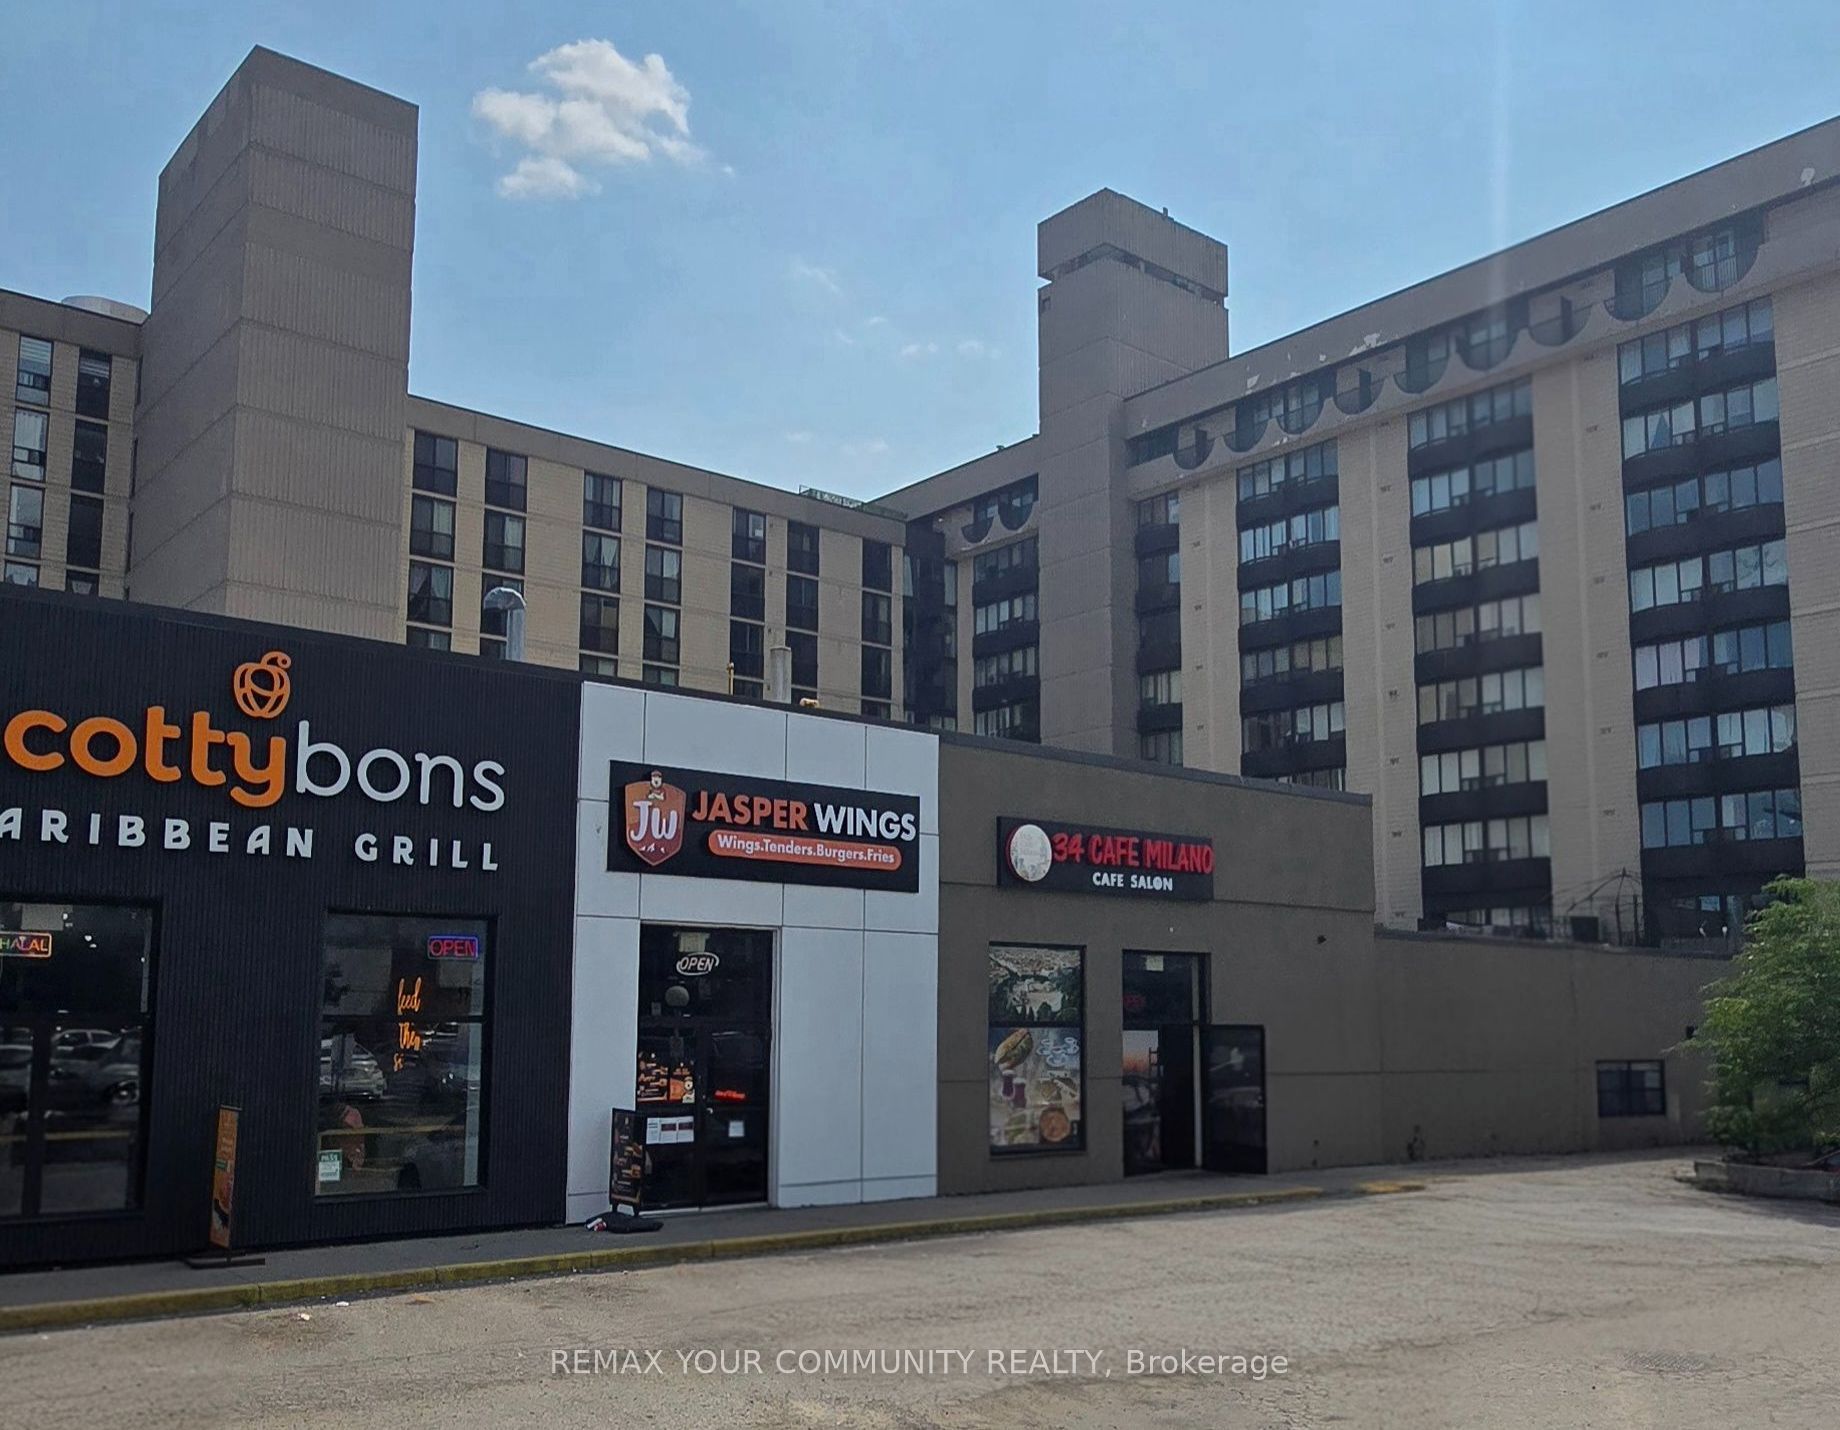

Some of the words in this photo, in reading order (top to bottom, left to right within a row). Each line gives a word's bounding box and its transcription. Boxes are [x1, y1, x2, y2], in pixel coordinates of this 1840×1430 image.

[4, 706, 506, 812] cottybons
[692, 790, 809, 831] JASPER
[813, 803, 917, 842] WINGS
[0, 807, 313, 858] ARIBBEAN
[355, 833, 499, 872] GRILL
[1051, 832, 1085, 864] 34
[1088, 834, 1140, 868] CAFE
[1143, 839, 1216, 875] MILANO
[1092, 872, 1125, 888] CAFE
[1130, 874, 1173, 892] SALON
[0, 937, 49, 952] HALAL
[430, 940, 476, 957] OPEN
[680, 956, 715, 972] OPEN
